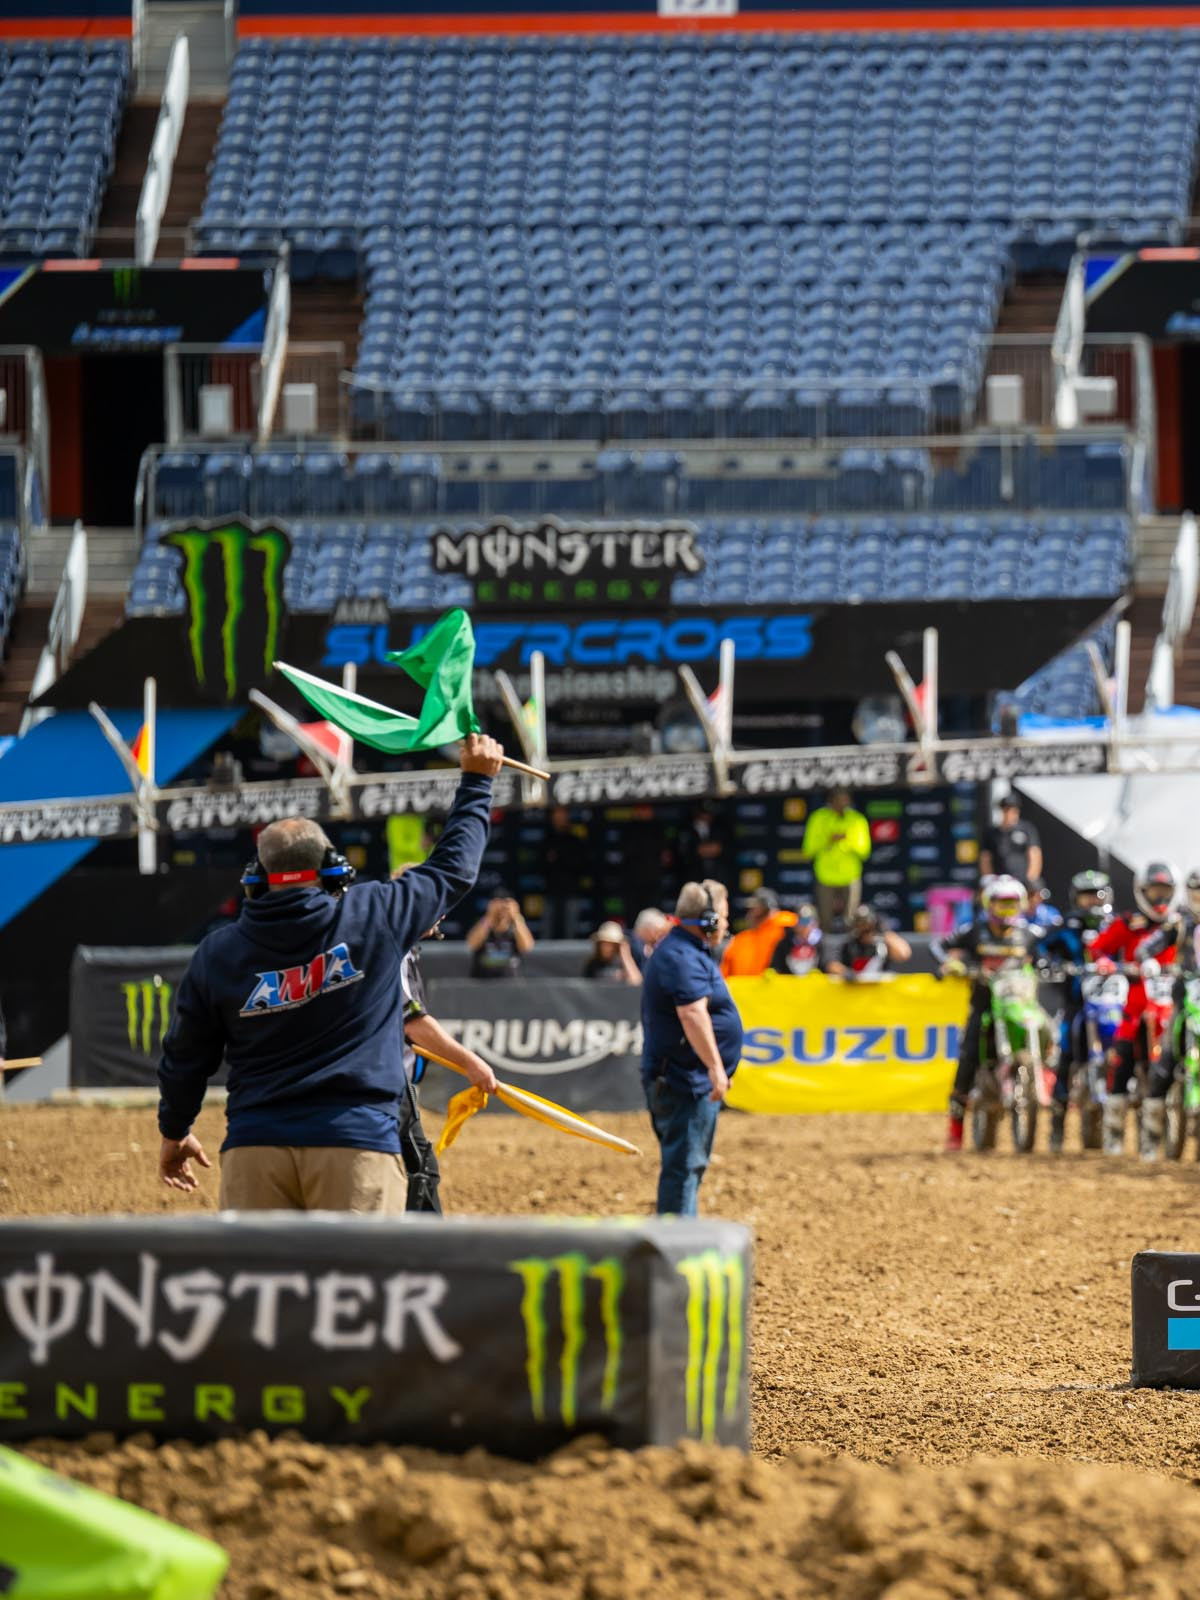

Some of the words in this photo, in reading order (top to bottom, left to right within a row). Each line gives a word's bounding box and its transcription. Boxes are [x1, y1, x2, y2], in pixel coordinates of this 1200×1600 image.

[436, 529, 702, 575] MONSTER
[477, 581, 661, 600] ENERGY
[240, 942, 364, 1012] AMA
[3, 1252, 459, 1365] ONSTER
[0, 1382, 372, 1422] ENERGY
